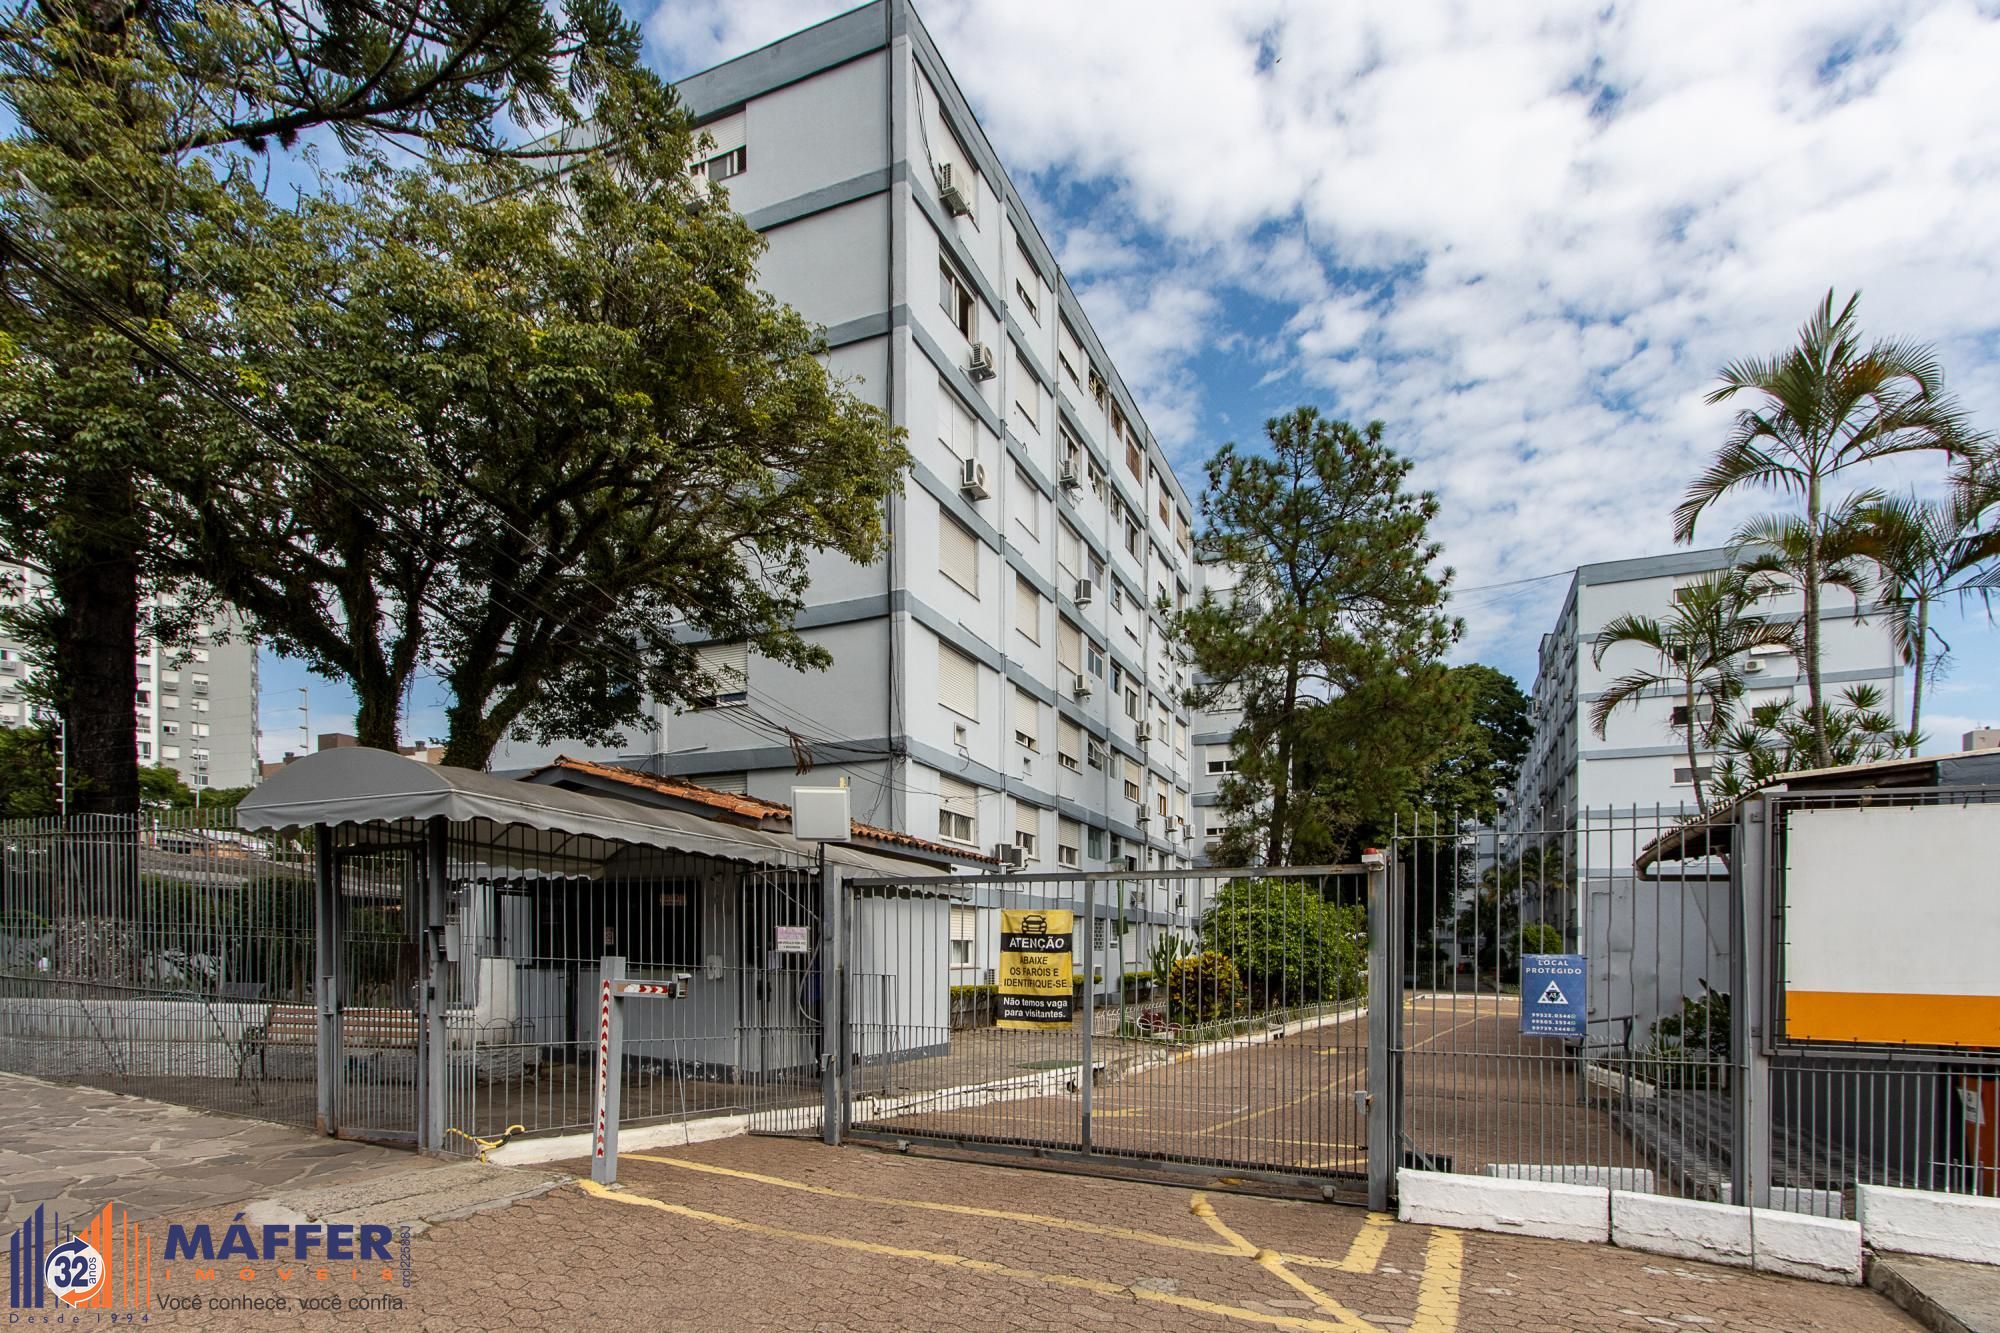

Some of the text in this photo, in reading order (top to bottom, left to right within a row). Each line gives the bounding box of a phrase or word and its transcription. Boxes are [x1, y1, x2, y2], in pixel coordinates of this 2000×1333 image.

[1009, 936, 1064, 950] ATENÇÃO
[1020, 956, 1048, 965] ABAIXE
[1009, 966, 1059, 977] OS FARÓIS E
[1004, 978, 1067, 988] IDENTIFIQUE-SE
[1003, 997, 1068, 1009] Não temos vaga
[1004, 1008, 1066, 1018] para visitantes.
